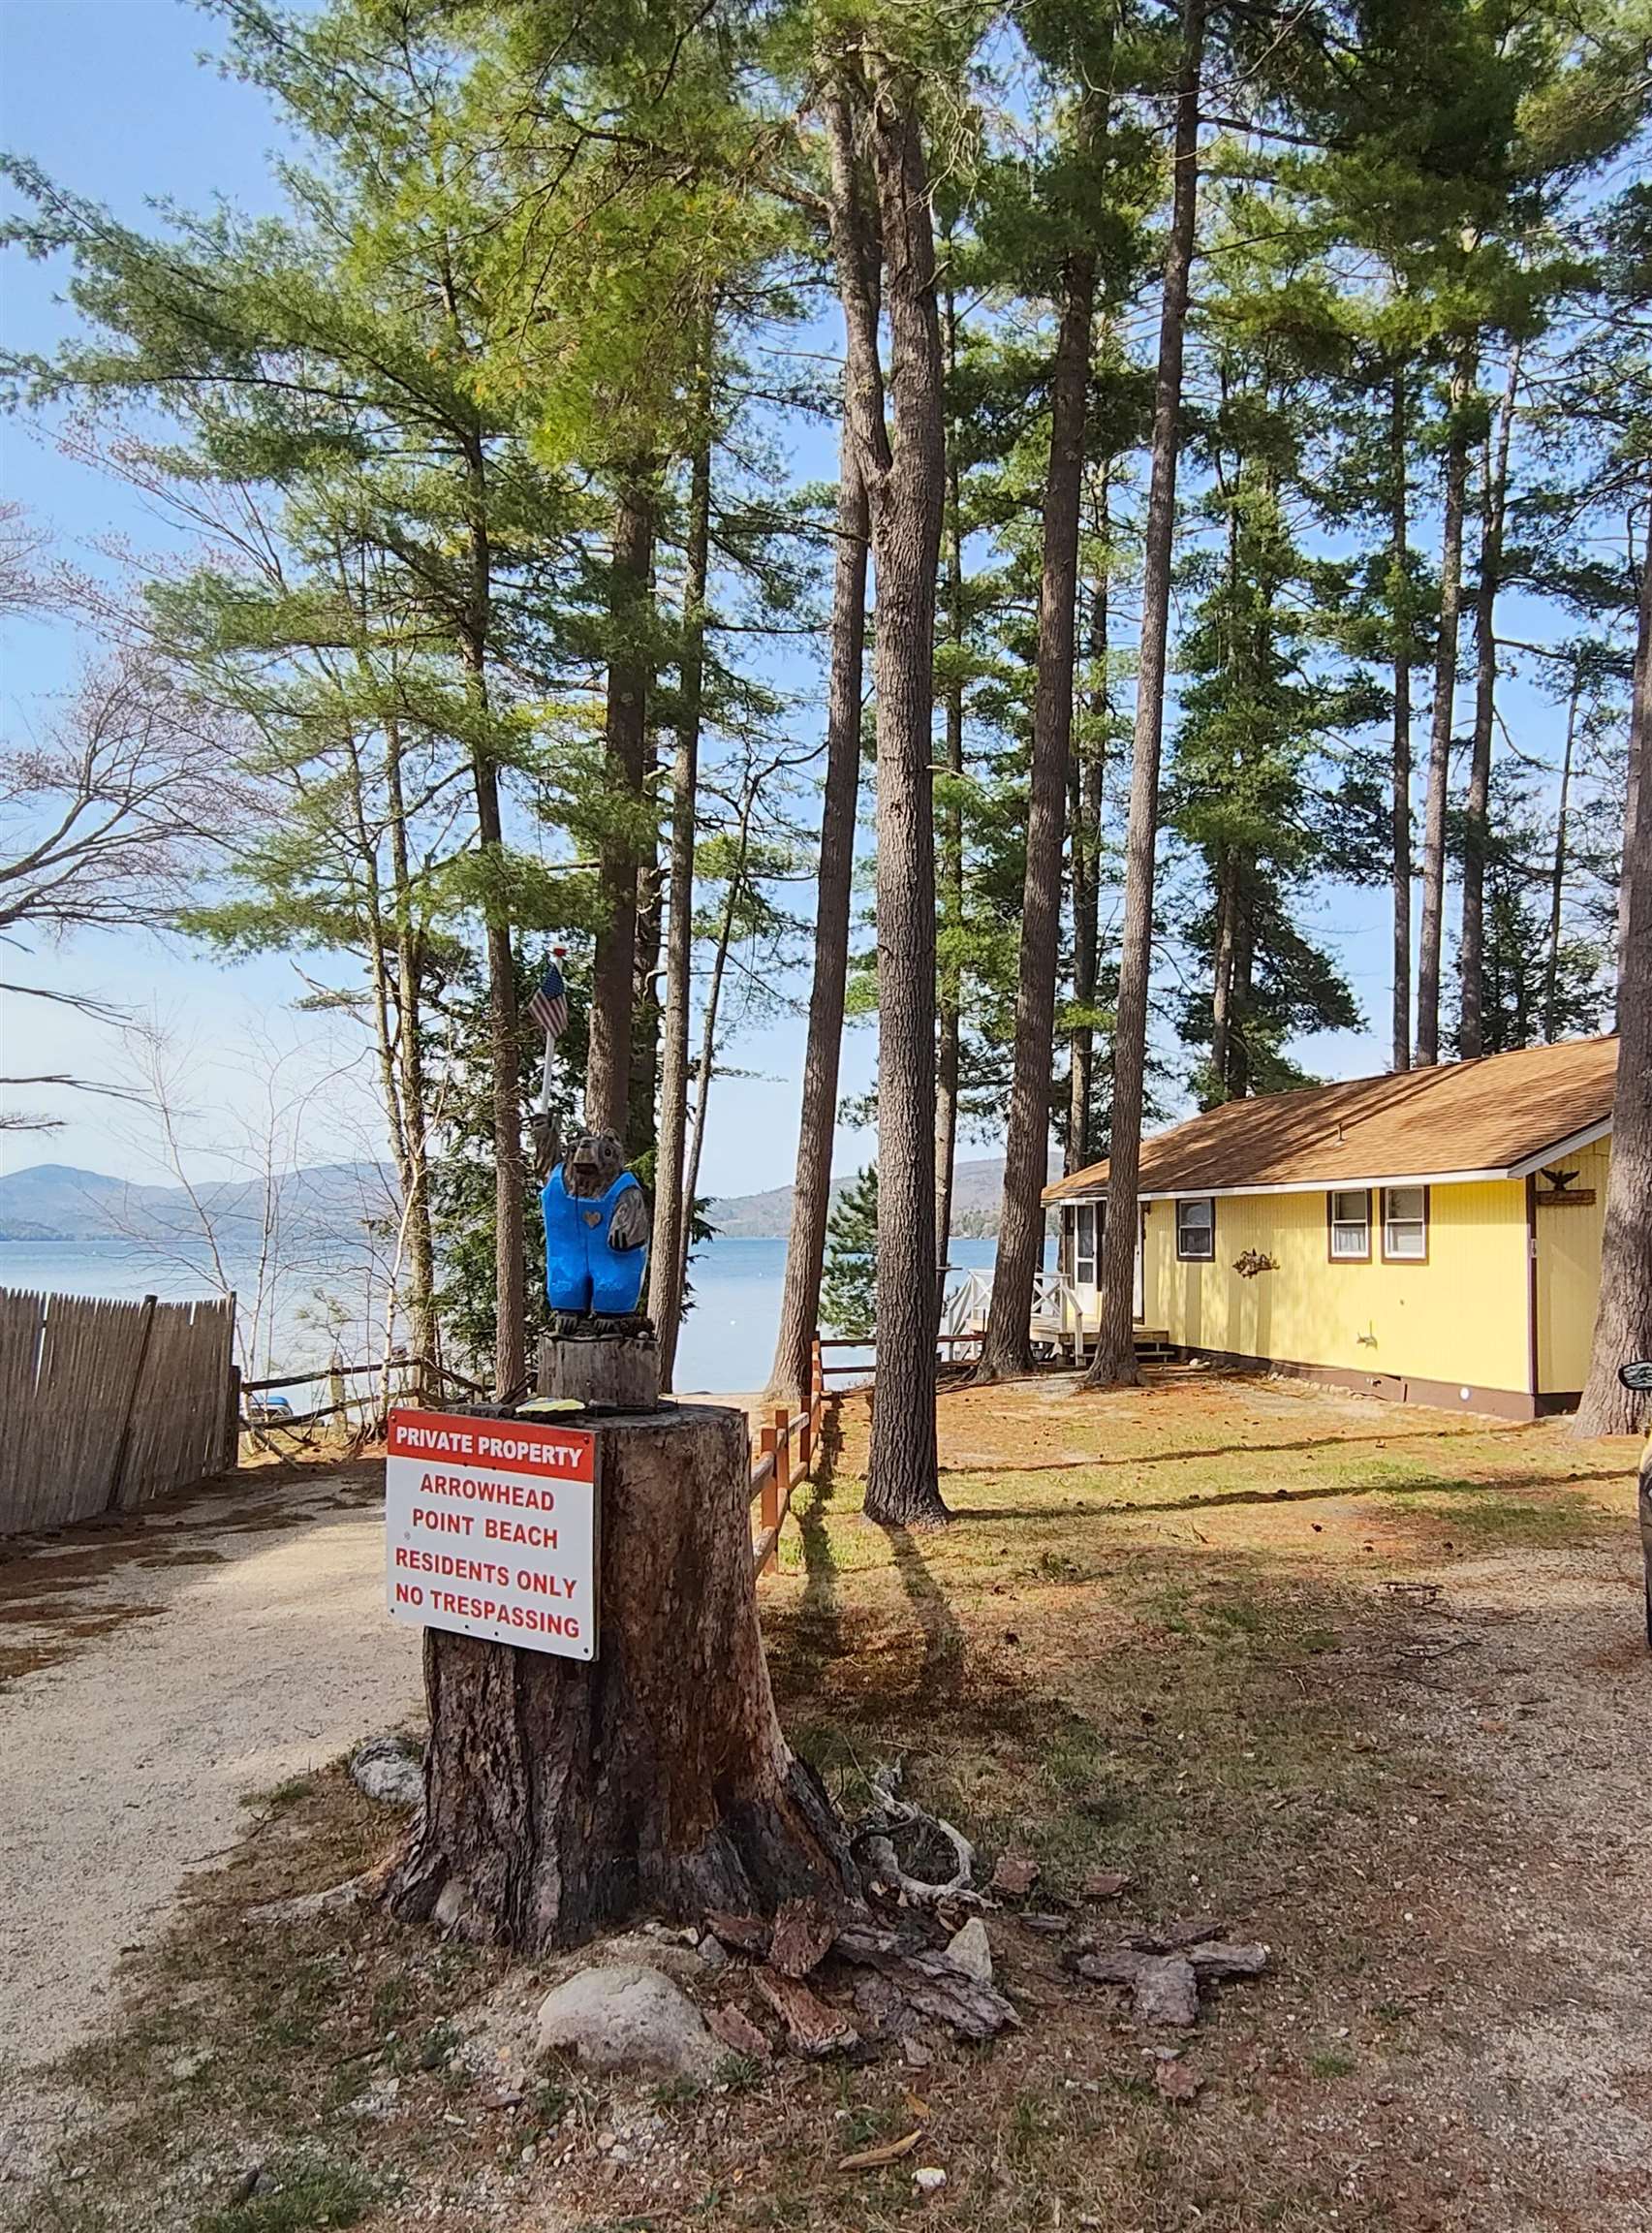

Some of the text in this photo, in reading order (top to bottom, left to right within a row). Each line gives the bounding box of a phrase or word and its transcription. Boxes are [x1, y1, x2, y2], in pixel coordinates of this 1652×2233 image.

[396, 1427, 582, 1467] PRIVATE PROPERTY
[420, 1473, 555, 1511] ARROWHEAD
[413, 1508, 558, 1549] POINT BEACH
[395, 1548, 577, 1599] RESIDENTS ONLY
[395, 1583, 579, 1639] NO TRESPASSING
